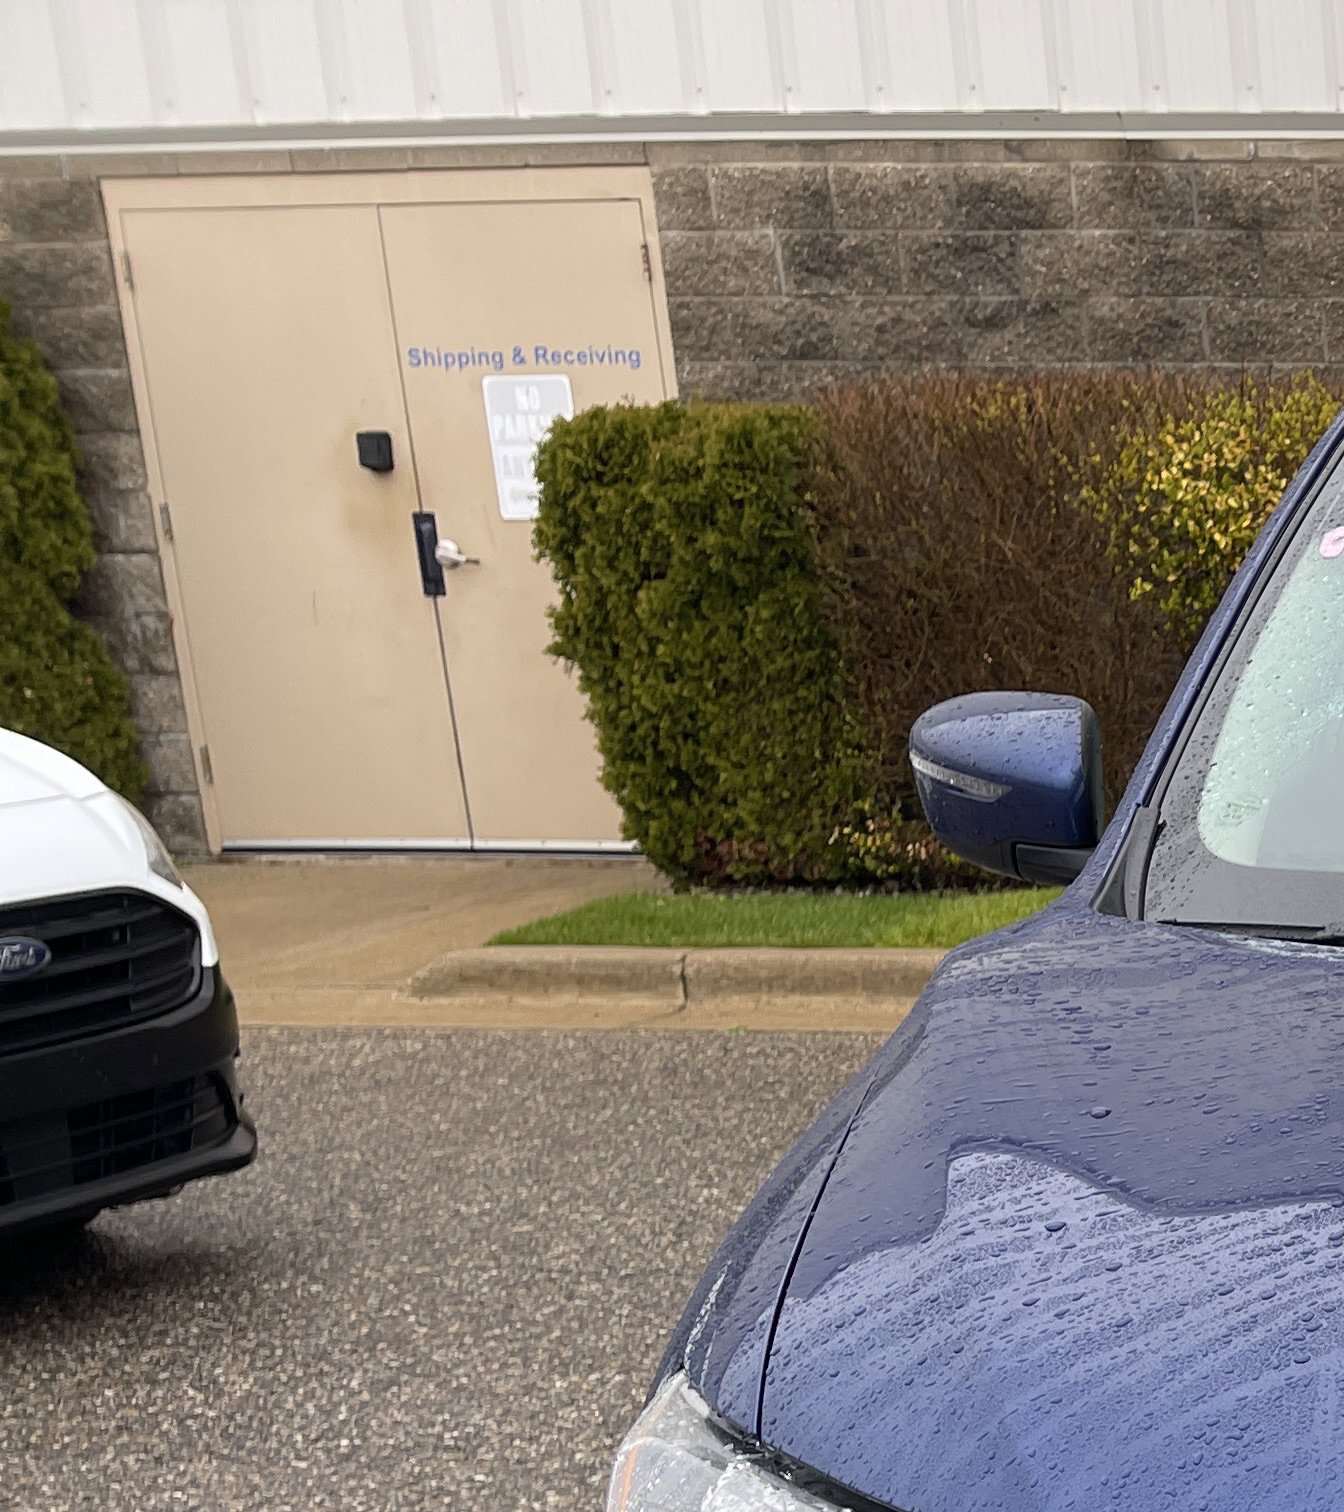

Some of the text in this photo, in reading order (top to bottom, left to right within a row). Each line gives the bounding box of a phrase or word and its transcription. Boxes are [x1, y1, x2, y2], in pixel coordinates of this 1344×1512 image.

[407, 344, 641, 371] Shipping & Receiving
